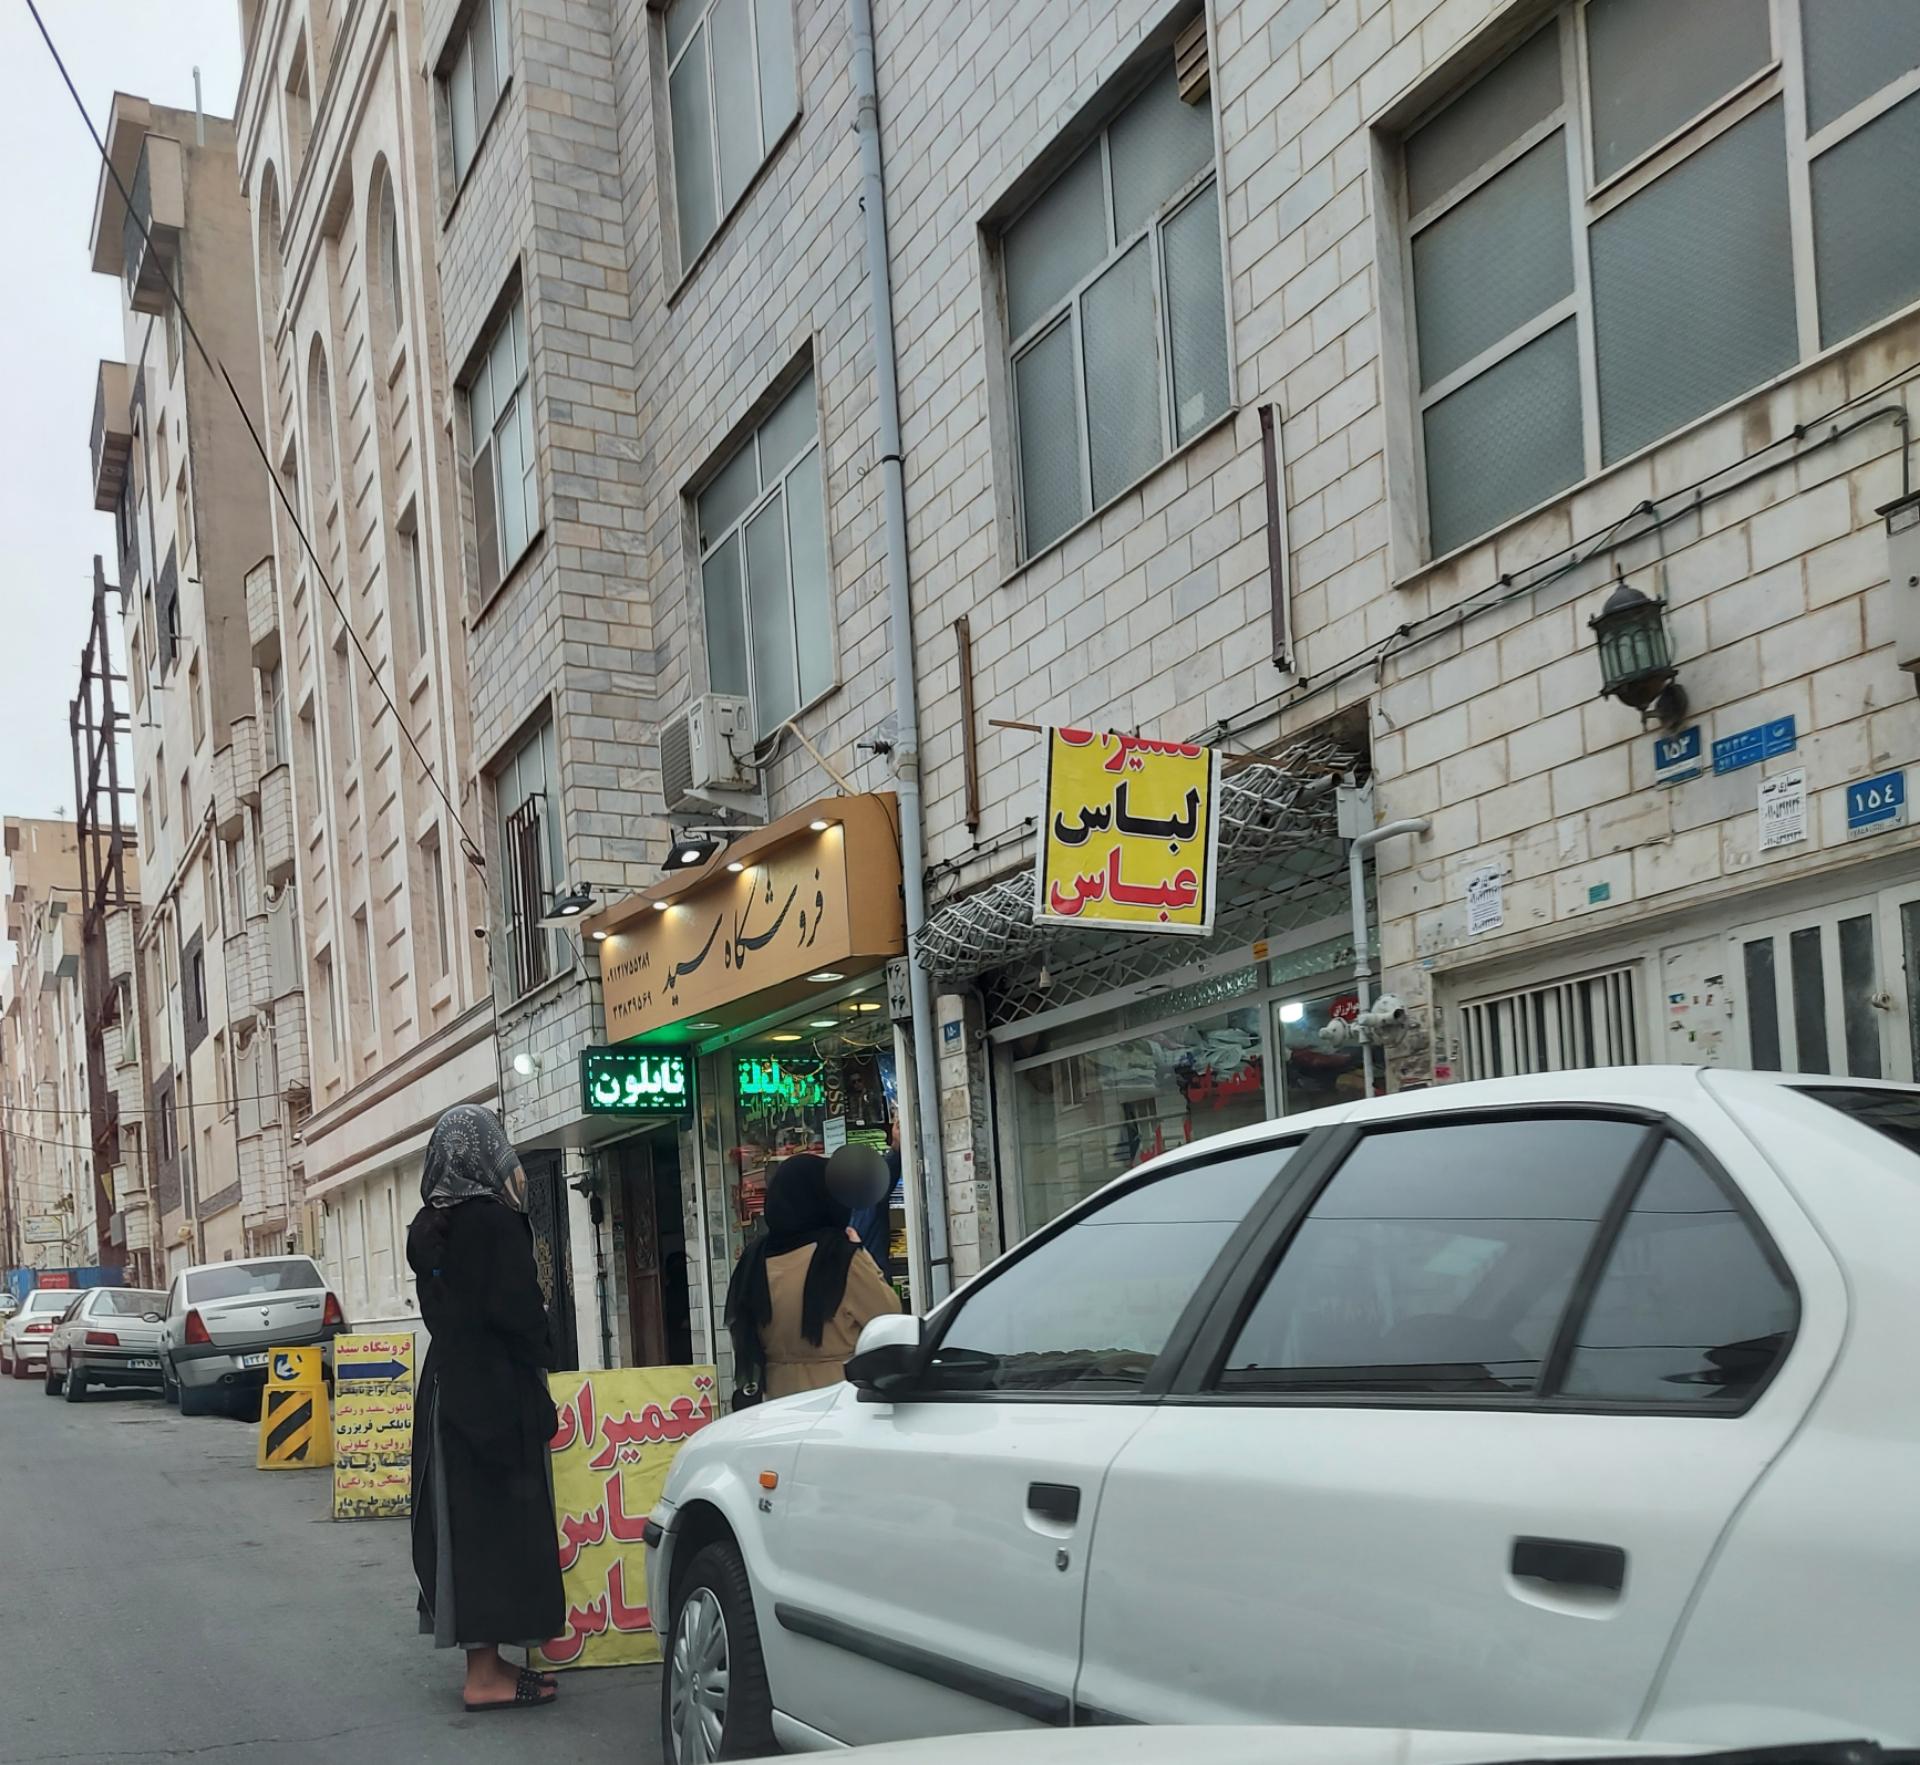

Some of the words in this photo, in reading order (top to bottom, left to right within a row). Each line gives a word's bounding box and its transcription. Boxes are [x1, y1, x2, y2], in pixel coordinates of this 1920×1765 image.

[1055, 781, 1200, 852] لباس
[725, 862, 824, 970] فروشگاه
[1051, 847, 1198, 922] عباس
[662, 912, 724, 1006] سید
[595, 1060, 685, 1104] نایلون
[362, 1339, 411, 1356] فروشگاه
